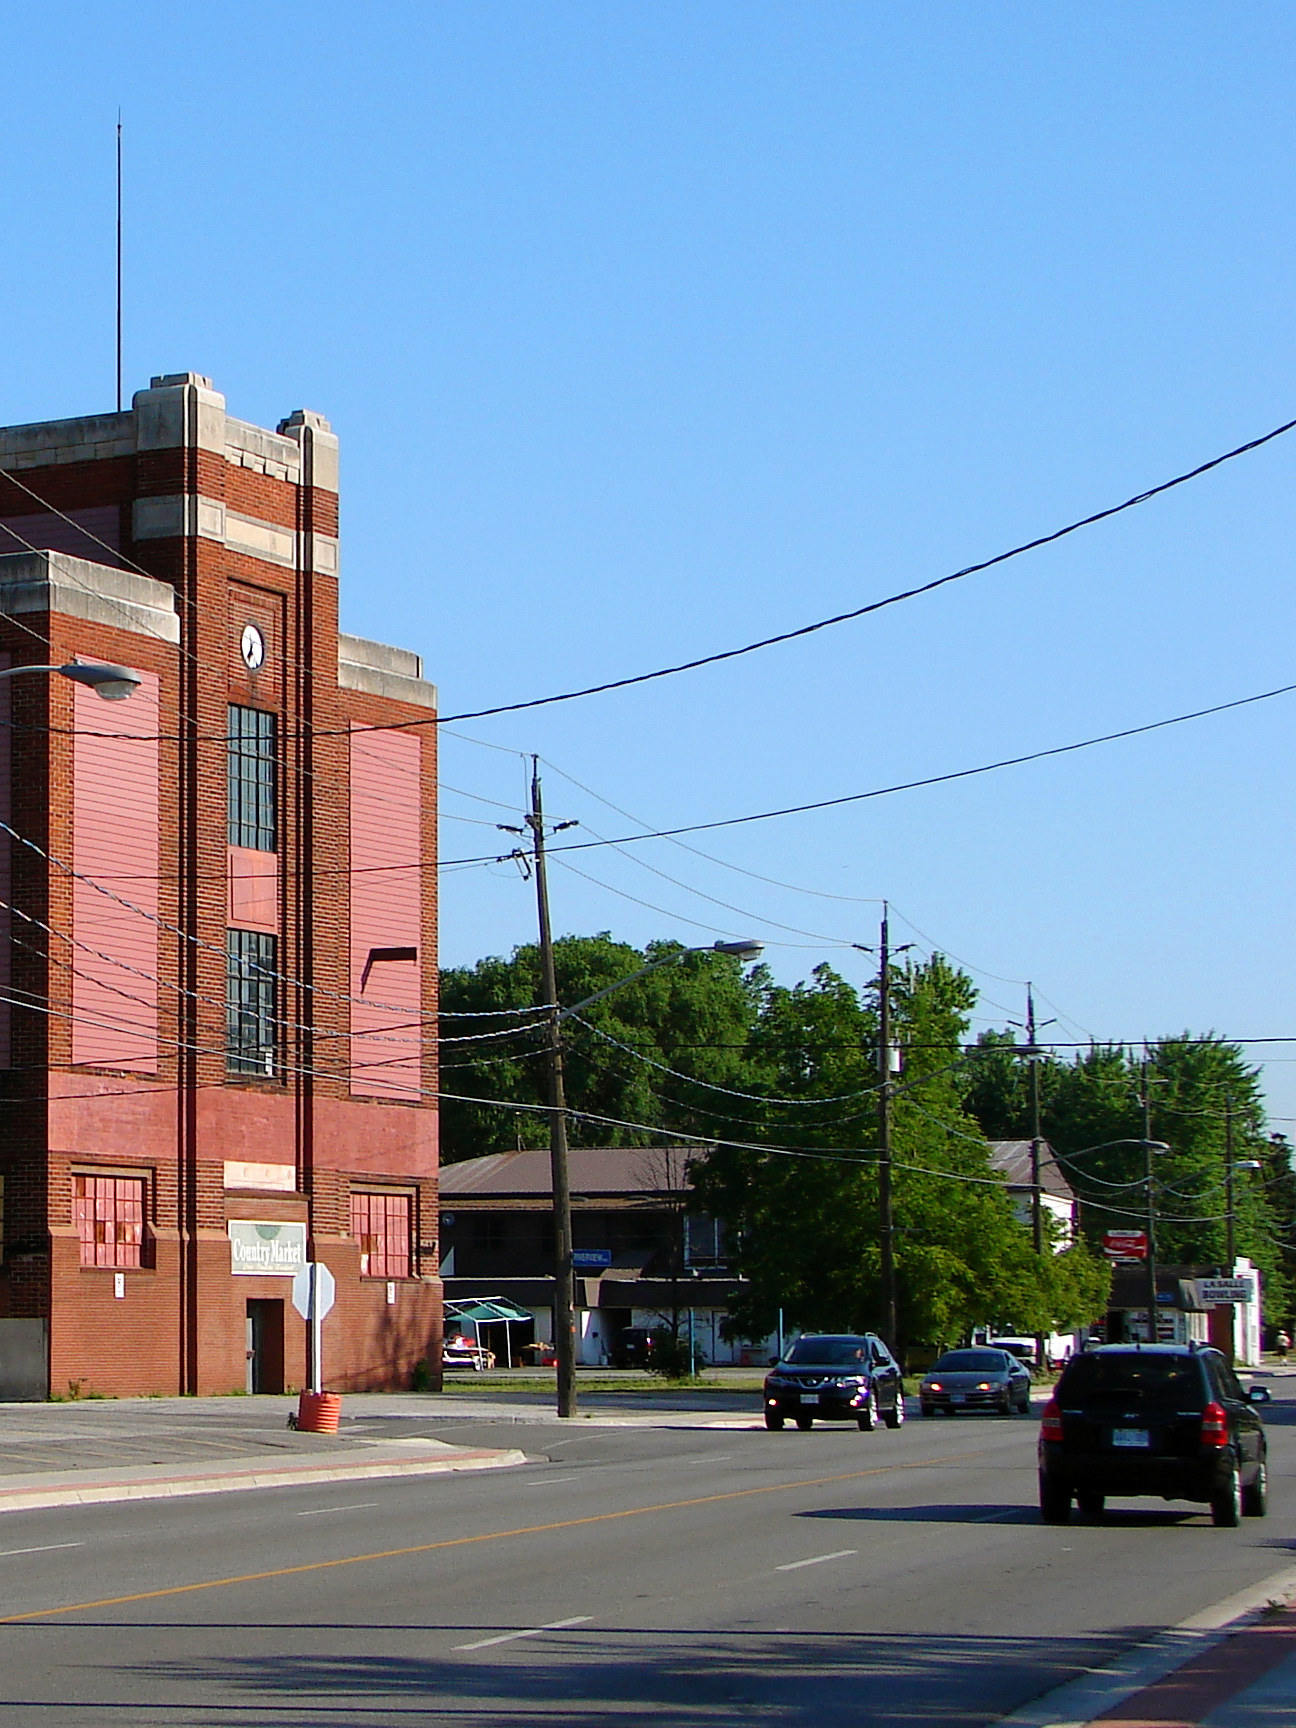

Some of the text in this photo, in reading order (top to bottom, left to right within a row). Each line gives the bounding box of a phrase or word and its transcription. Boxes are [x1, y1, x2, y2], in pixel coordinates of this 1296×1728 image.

[233, 1237, 302, 1266] Country Market
[1202, 1290, 1247, 1299] BOWLING
